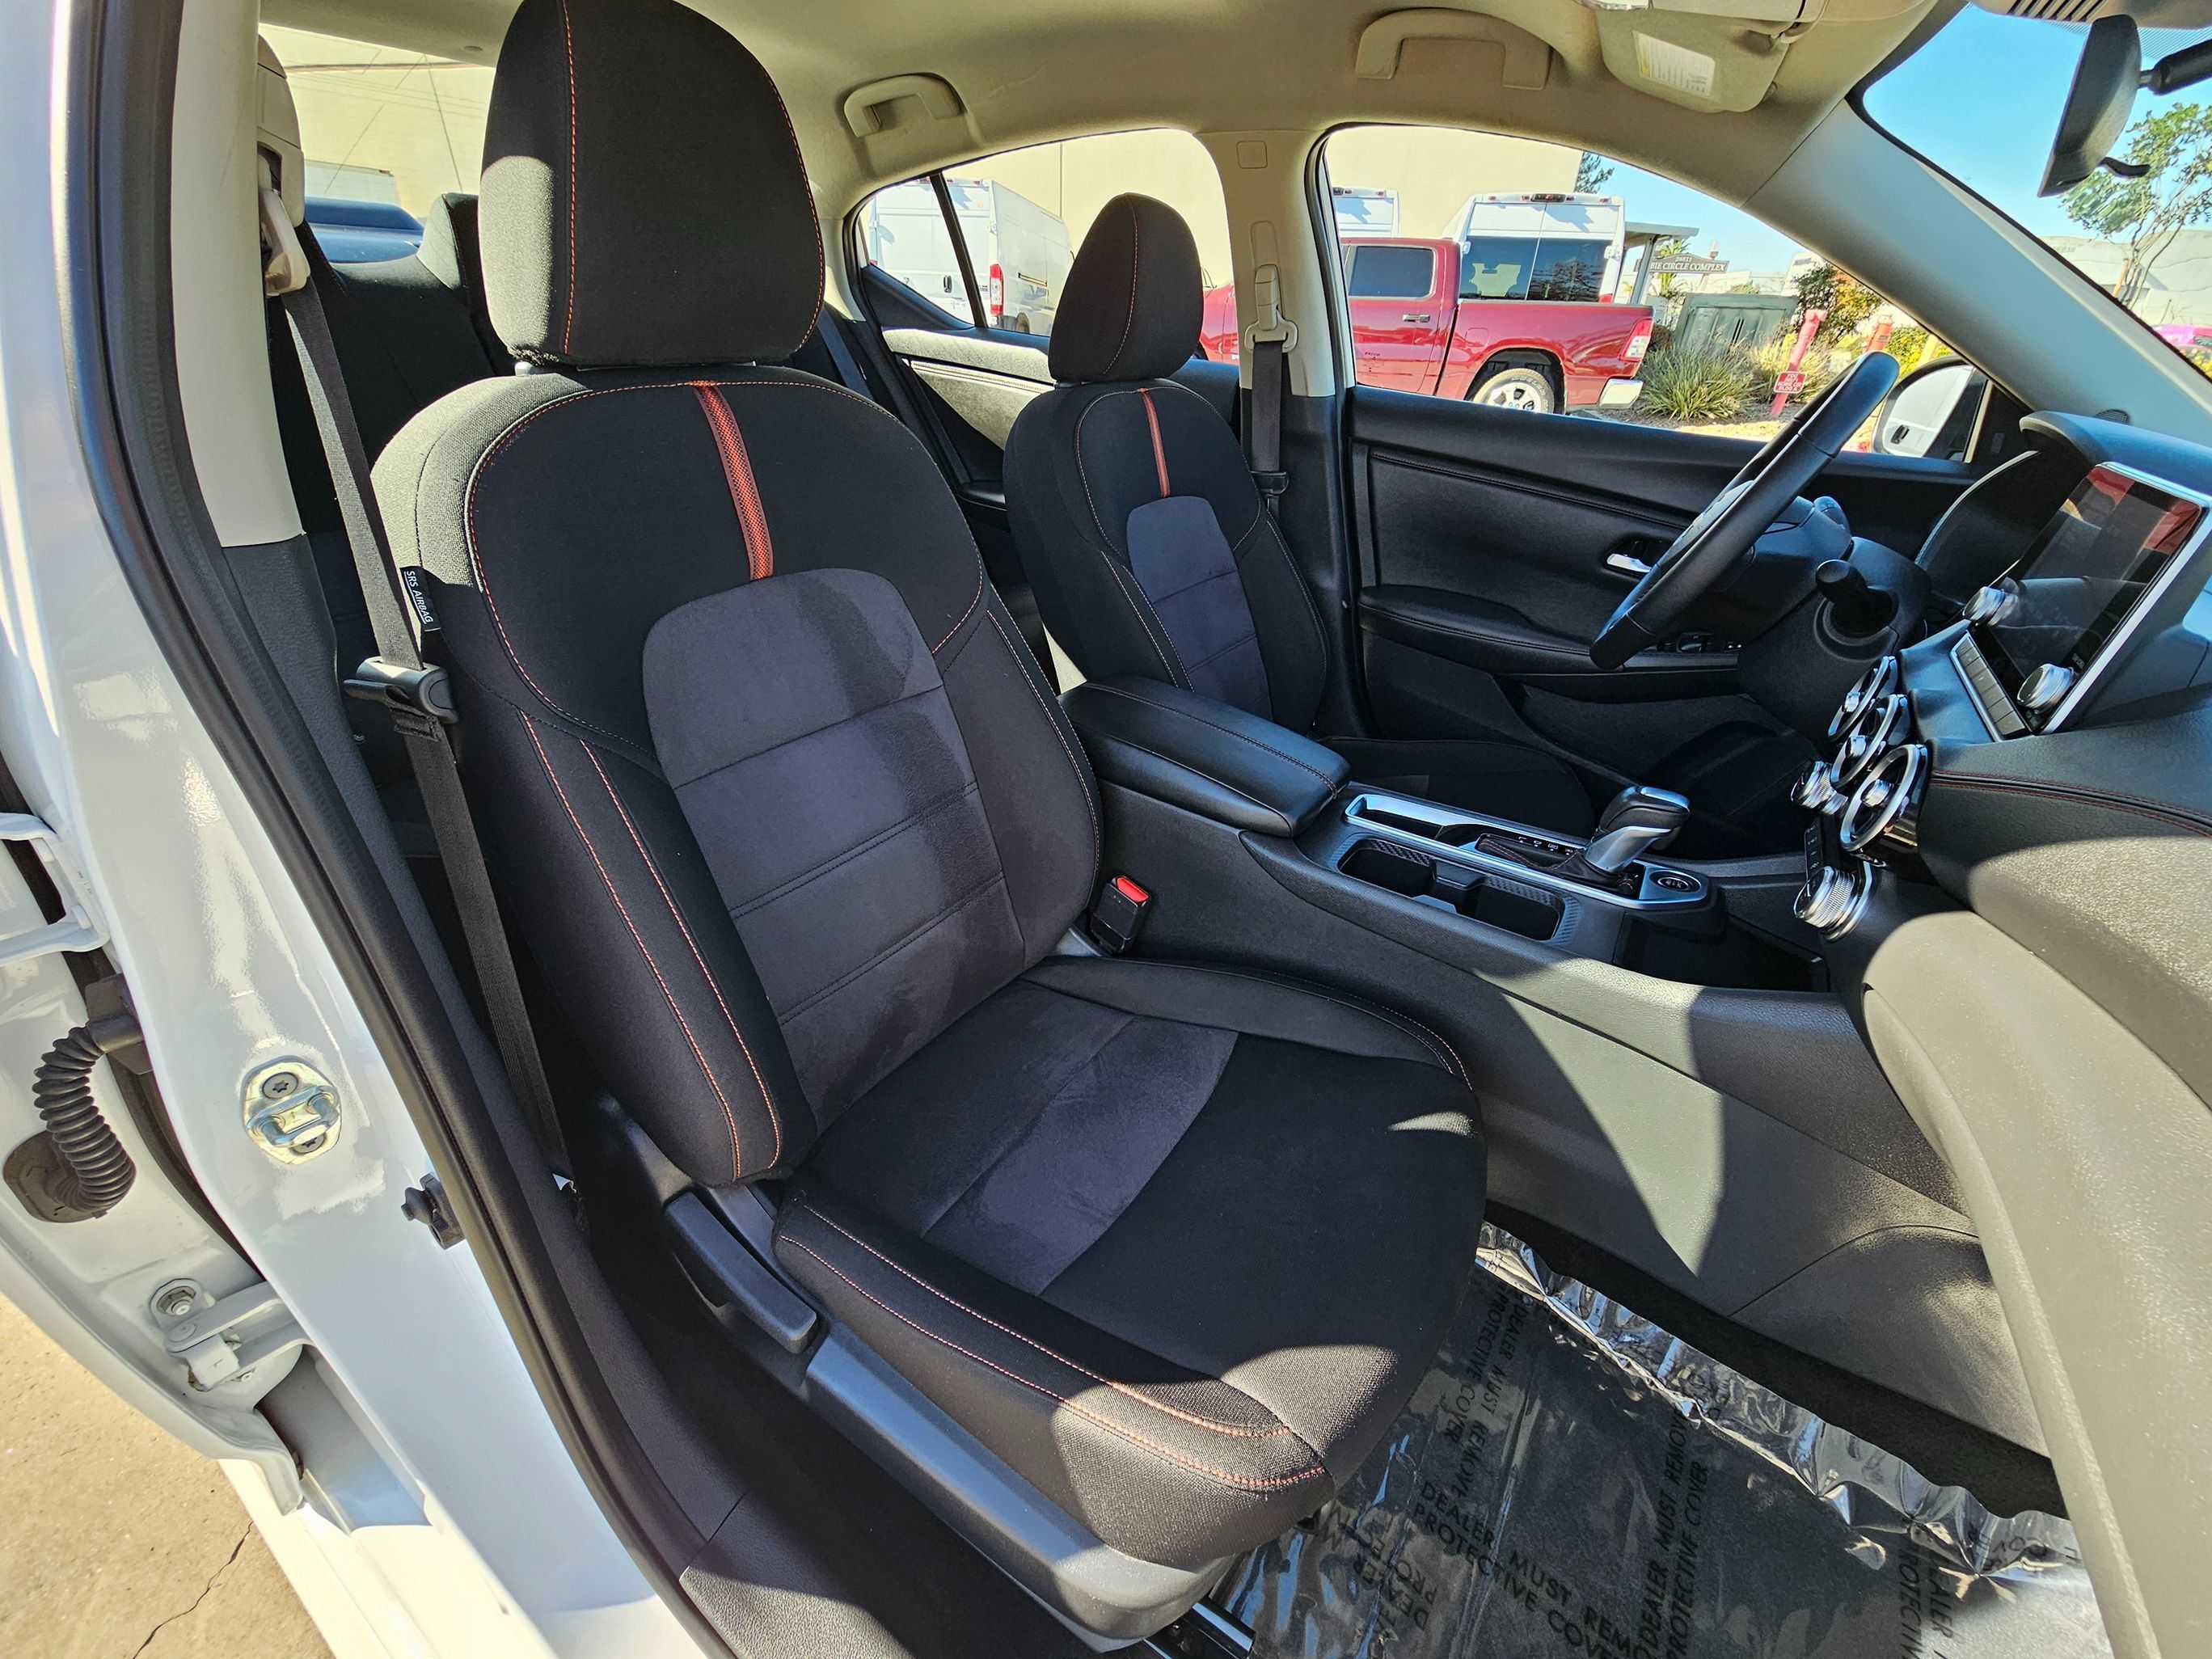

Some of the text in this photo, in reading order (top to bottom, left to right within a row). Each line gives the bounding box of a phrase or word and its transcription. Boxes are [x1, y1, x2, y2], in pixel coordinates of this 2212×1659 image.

[1662, 262, 1690, 270] CIRCLE
[1690, 263, 1725, 272] COMPLEX
[406, 571, 433, 623] SRS AIRBAG
[1501, 1303, 1529, 1361] DEALER
[1444, 1384, 1476, 1445] COVER
[1480, 1365, 1507, 1416] MUST
[1684, 1460, 1709, 1527] COVER
[1412, 1502, 1540, 1612] PROTECTIVE
[1422, 1480, 1496, 1547] DEALER
[1509, 1550, 1573, 1607] MUST
[1636, 1559, 1670, 1647] DEALER
[1653, 1490, 1678, 1552] MUST
